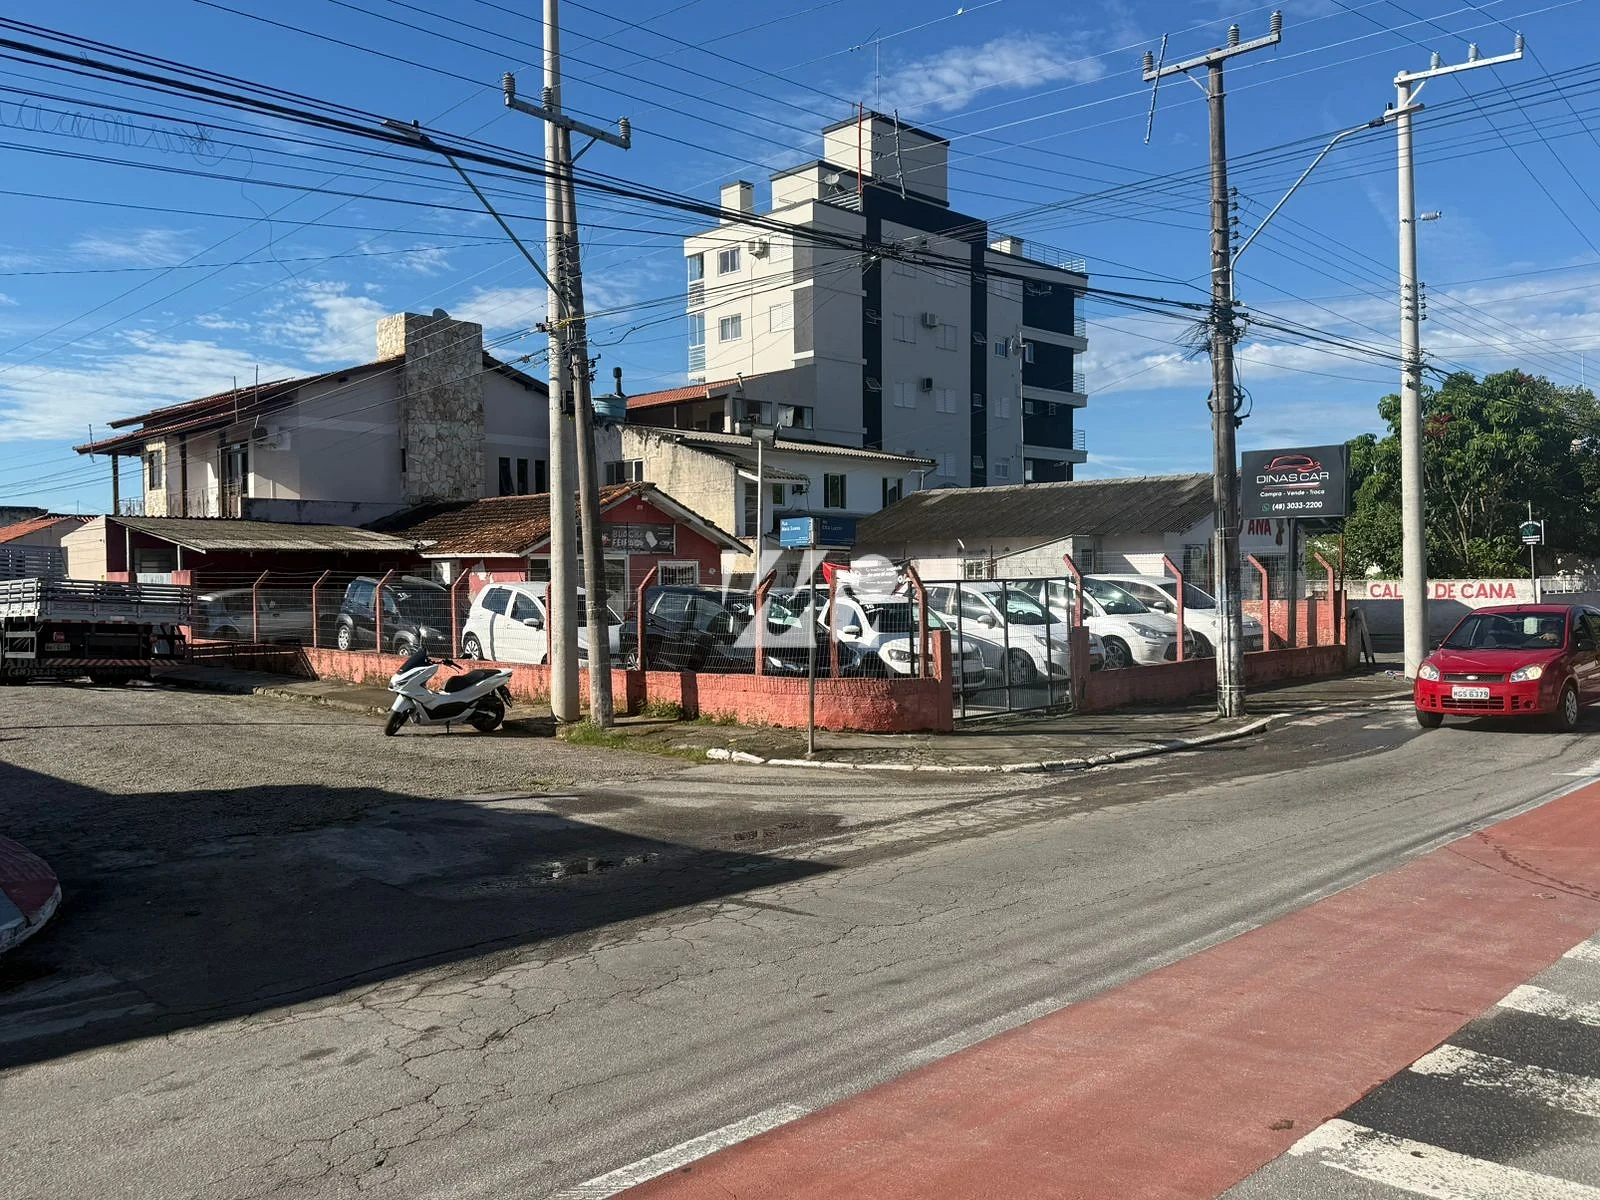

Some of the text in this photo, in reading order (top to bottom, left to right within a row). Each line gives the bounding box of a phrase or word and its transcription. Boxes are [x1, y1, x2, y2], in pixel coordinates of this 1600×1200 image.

[1256, 471, 1329, 484] DINAS CAR
[1286, 501, 1323, 510] 3033-2200
[1369, 582, 1517, 599] CAL DE CANA
